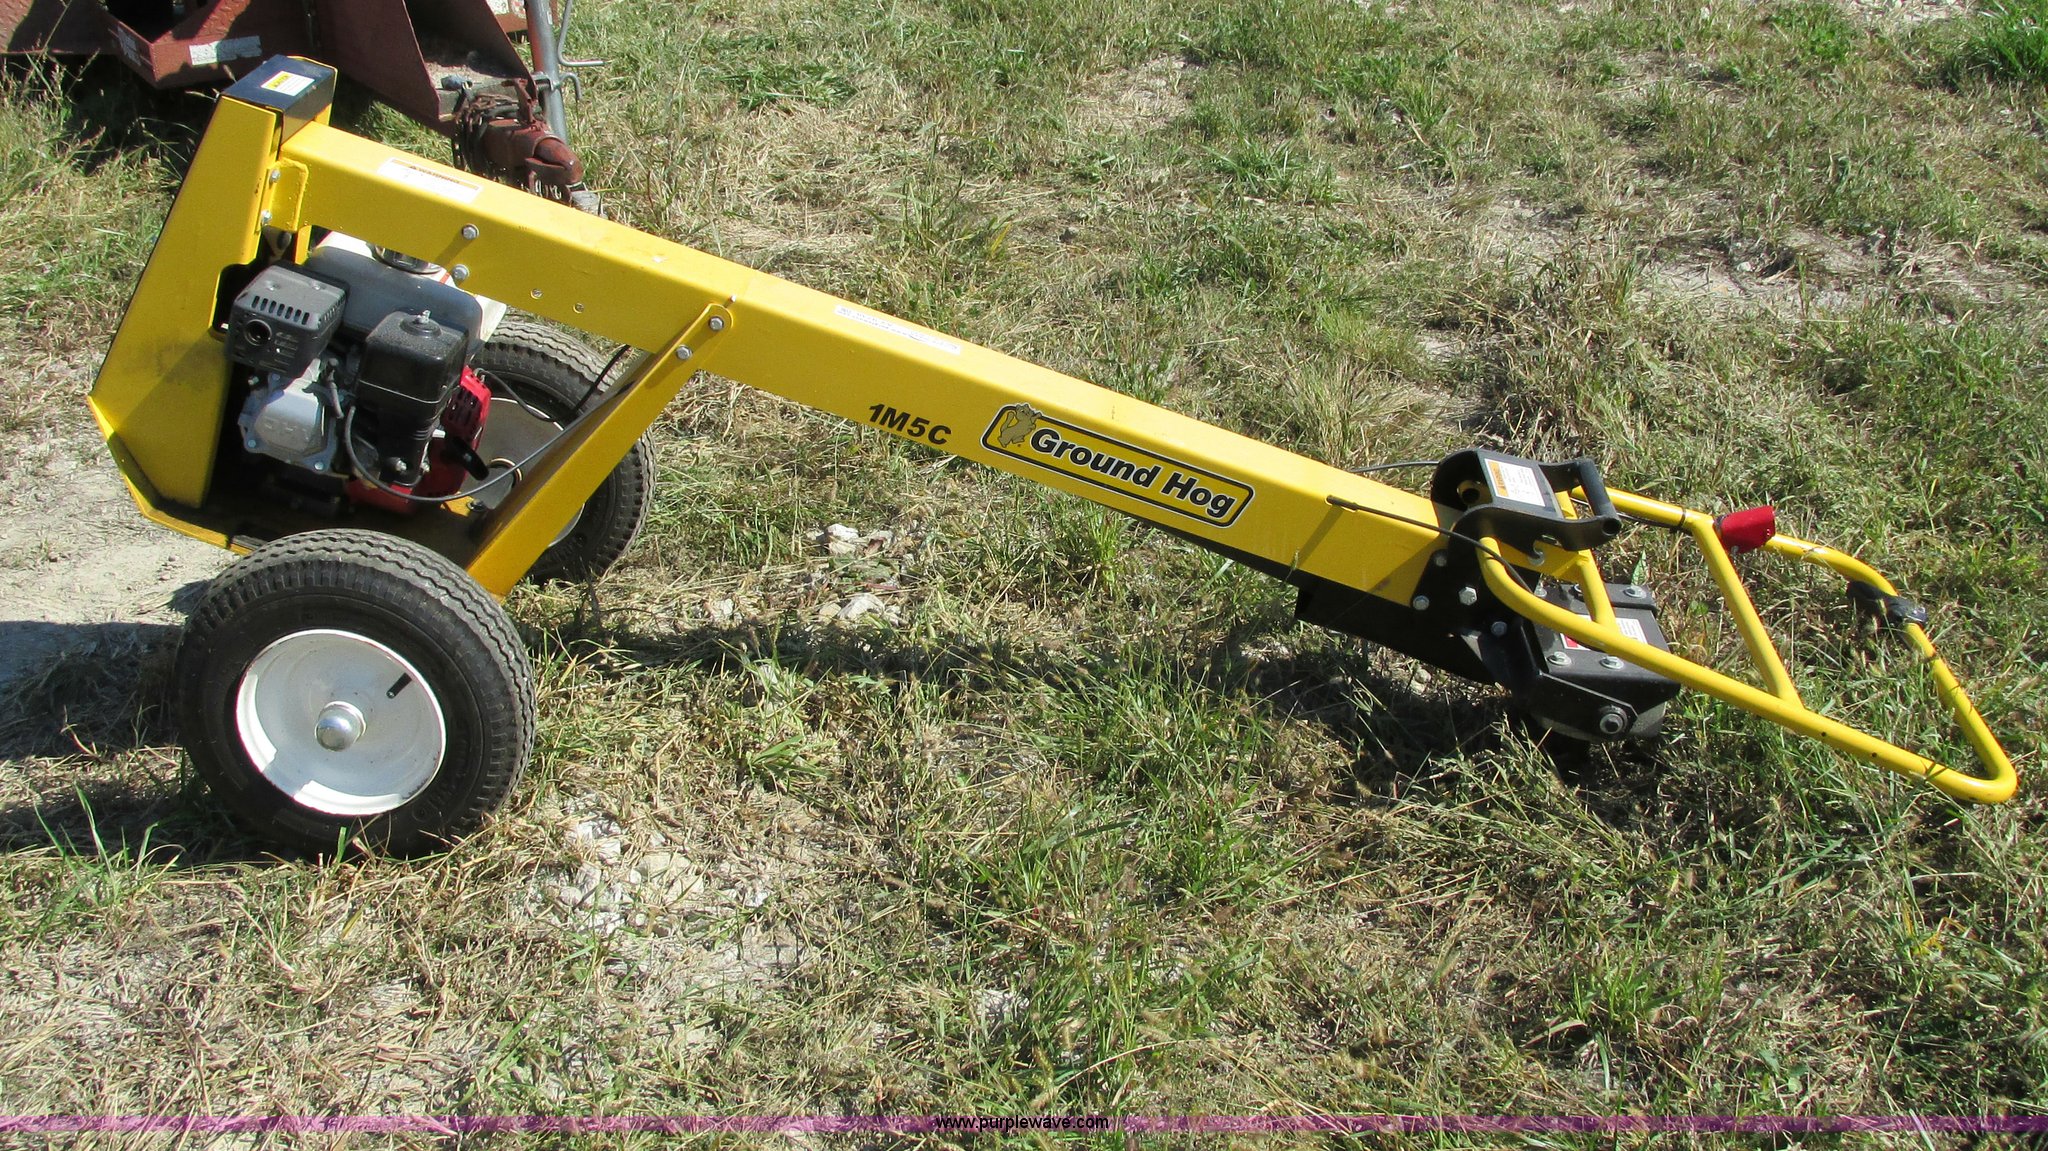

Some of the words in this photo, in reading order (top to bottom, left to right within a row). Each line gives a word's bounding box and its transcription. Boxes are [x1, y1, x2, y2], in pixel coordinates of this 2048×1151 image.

[868, 403, 952, 446] 1M5C
[1030, 427, 1162, 489] Ground
[1161, 471, 1235, 517] Hog
